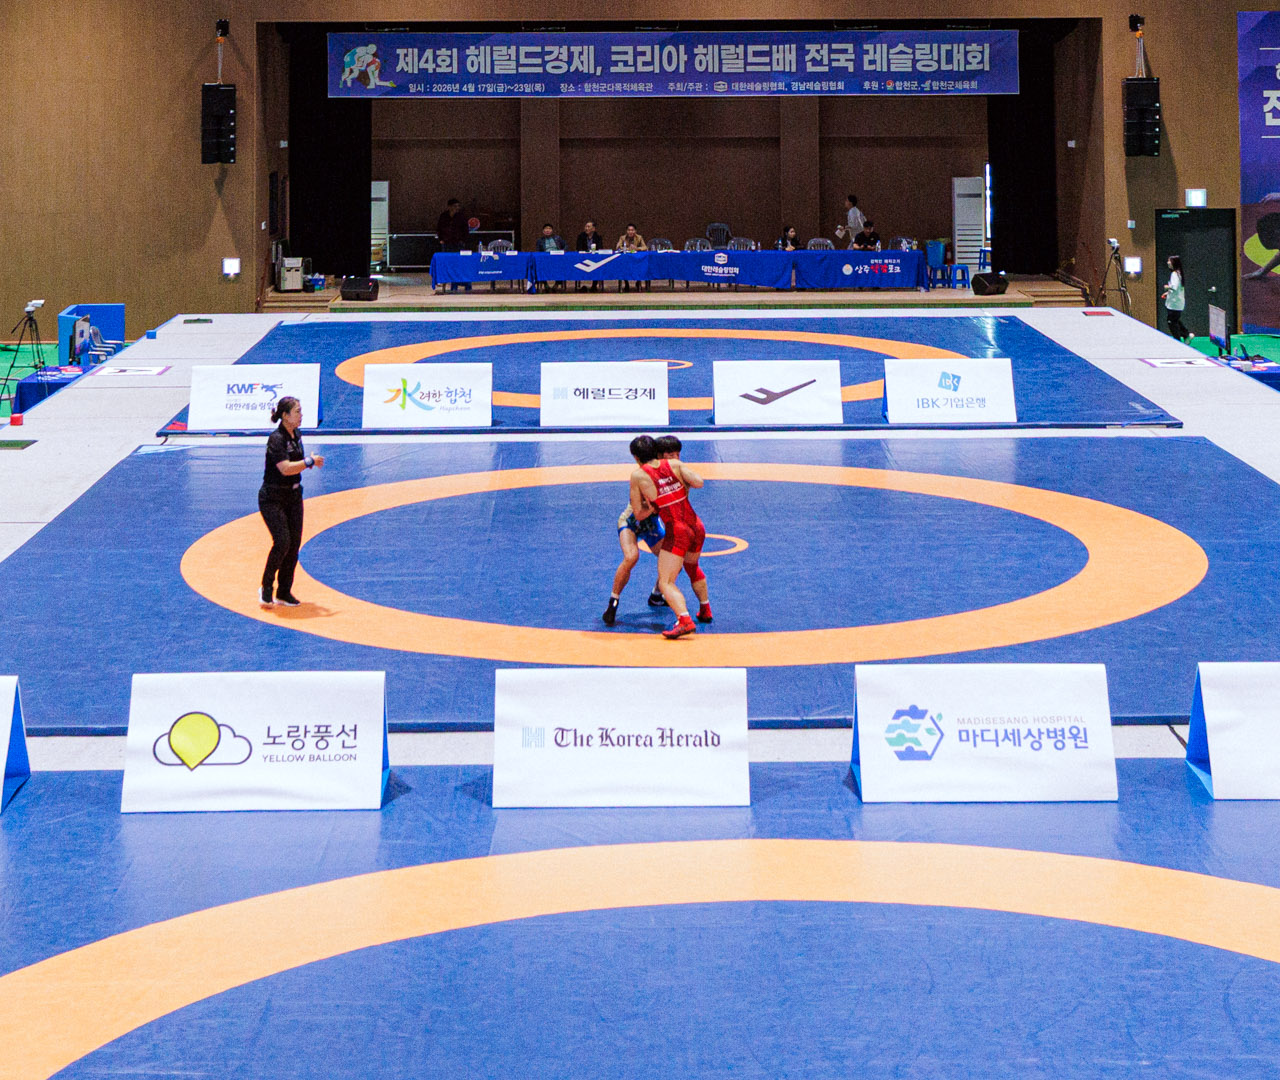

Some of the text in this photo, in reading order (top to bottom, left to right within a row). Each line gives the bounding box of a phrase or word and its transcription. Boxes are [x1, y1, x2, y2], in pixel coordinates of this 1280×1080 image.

[395, 43, 991, 76] 제4회 헤럴드경제, 코리아 헤럴드배 전국 레슬링대회
[408, 83, 425, 93] 일시
[432, 83, 460, 93] 2026년
[462, 83, 475, 93] 4월
[560, 83, 575, 92] 장소
[584, 82, 654, 93] 합천군다목적체육관
[863, 81, 879, 91] 후원
[226, 382, 260, 395] KWF
[445, 386, 473, 402] 합천
[573, 387, 656, 400] 헤럴드경제
[225, 401, 279, 412] 대한레슬링협
[957, 715, 1086, 725] MADISESANG HOSPITAL
[262, 724, 358, 751] 노랑풍선
[554, 727, 721, 748] The Korea Herald
[958, 725, 1089, 751] 마디세상병원
[262, 753, 357, 763] YELLOW BALLOON
